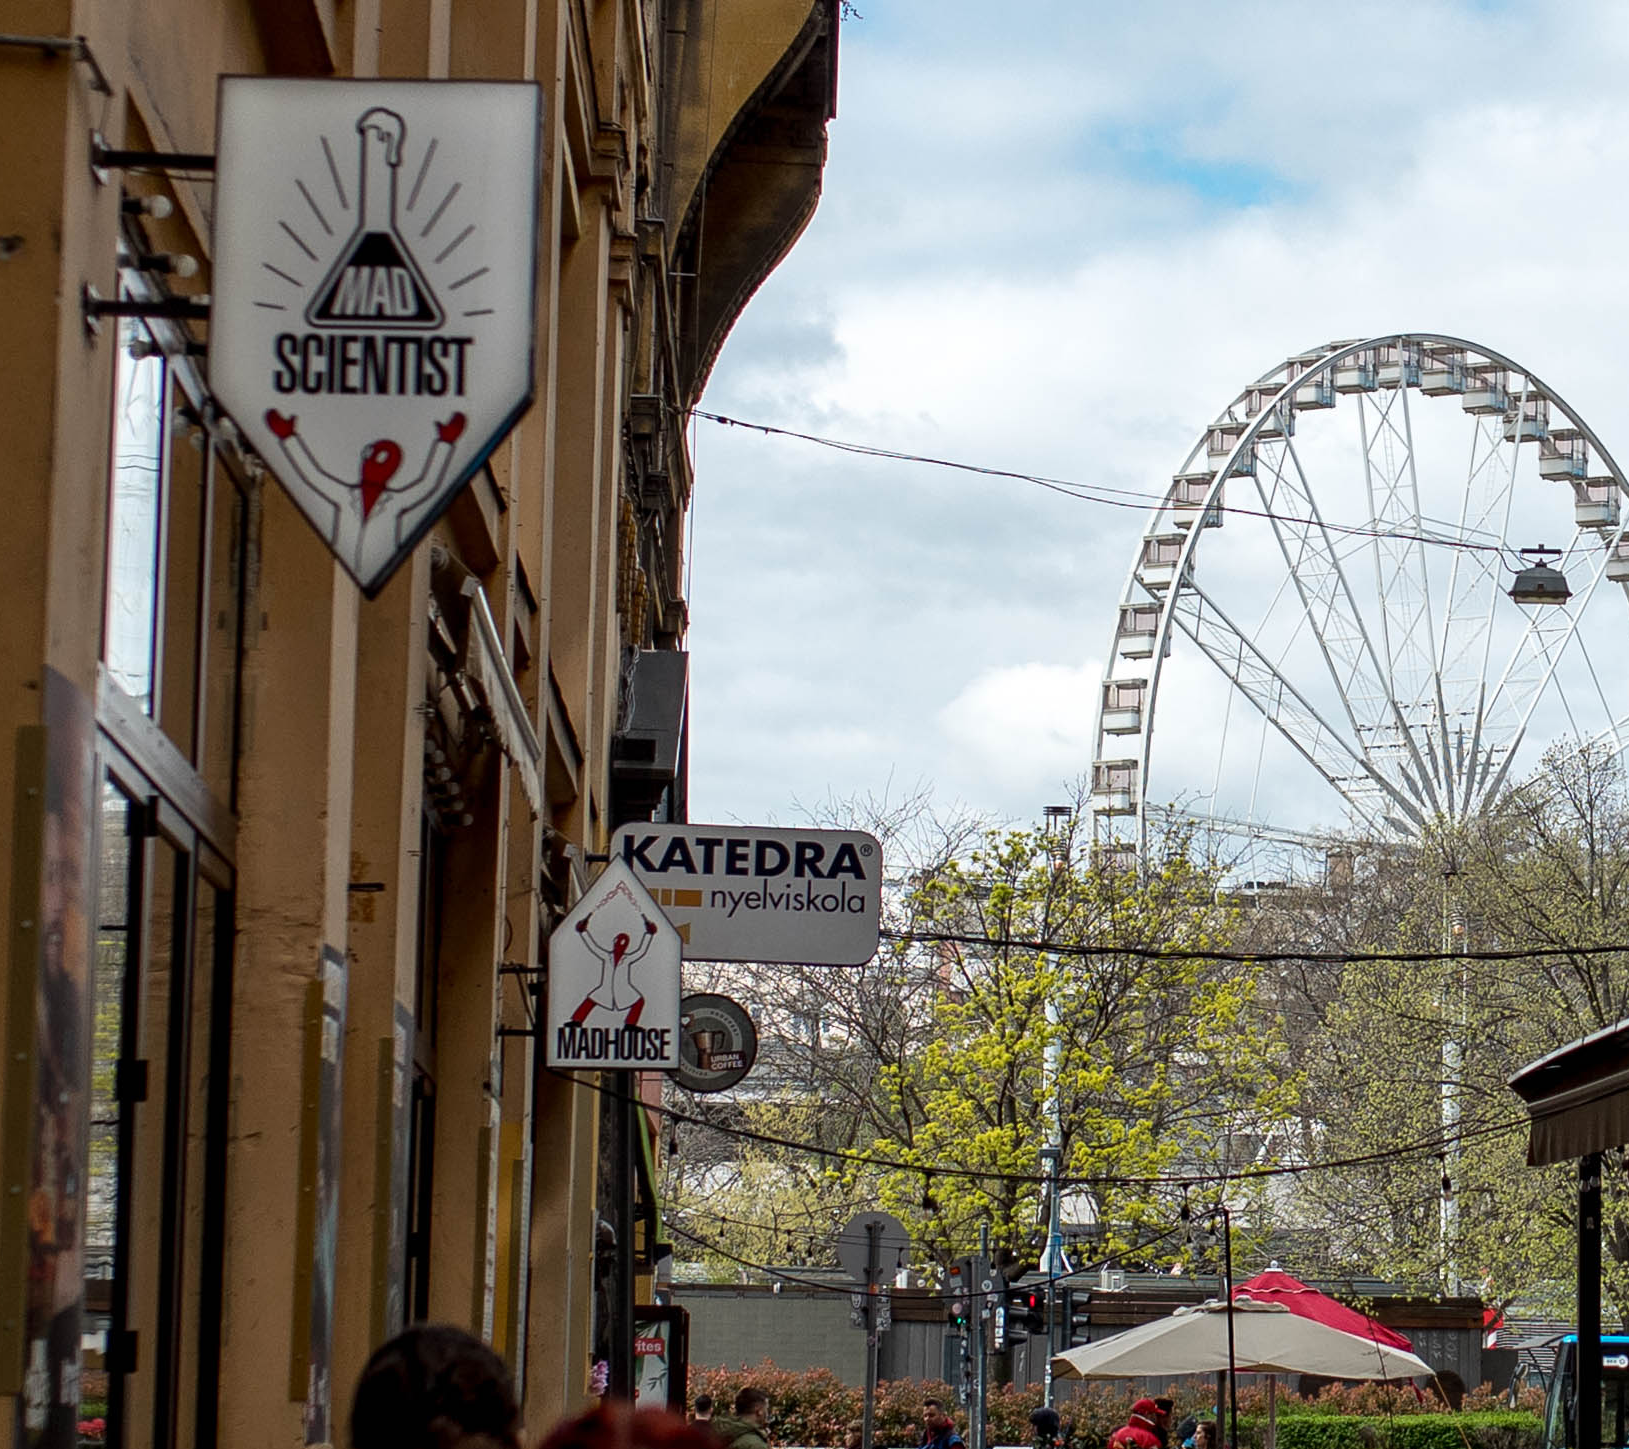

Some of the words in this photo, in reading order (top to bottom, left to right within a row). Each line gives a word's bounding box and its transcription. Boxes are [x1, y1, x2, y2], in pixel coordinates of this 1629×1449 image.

[330, 264, 420, 318] MAD
[274, 334, 473, 396] SCIENTIST
[624, 834, 866, 880] KATEDRA
[711, 879, 866, 918] nyelviskola
[710, 1054, 740, 1064] URBAN
[710, 1061, 745, 1071] COFFEE
